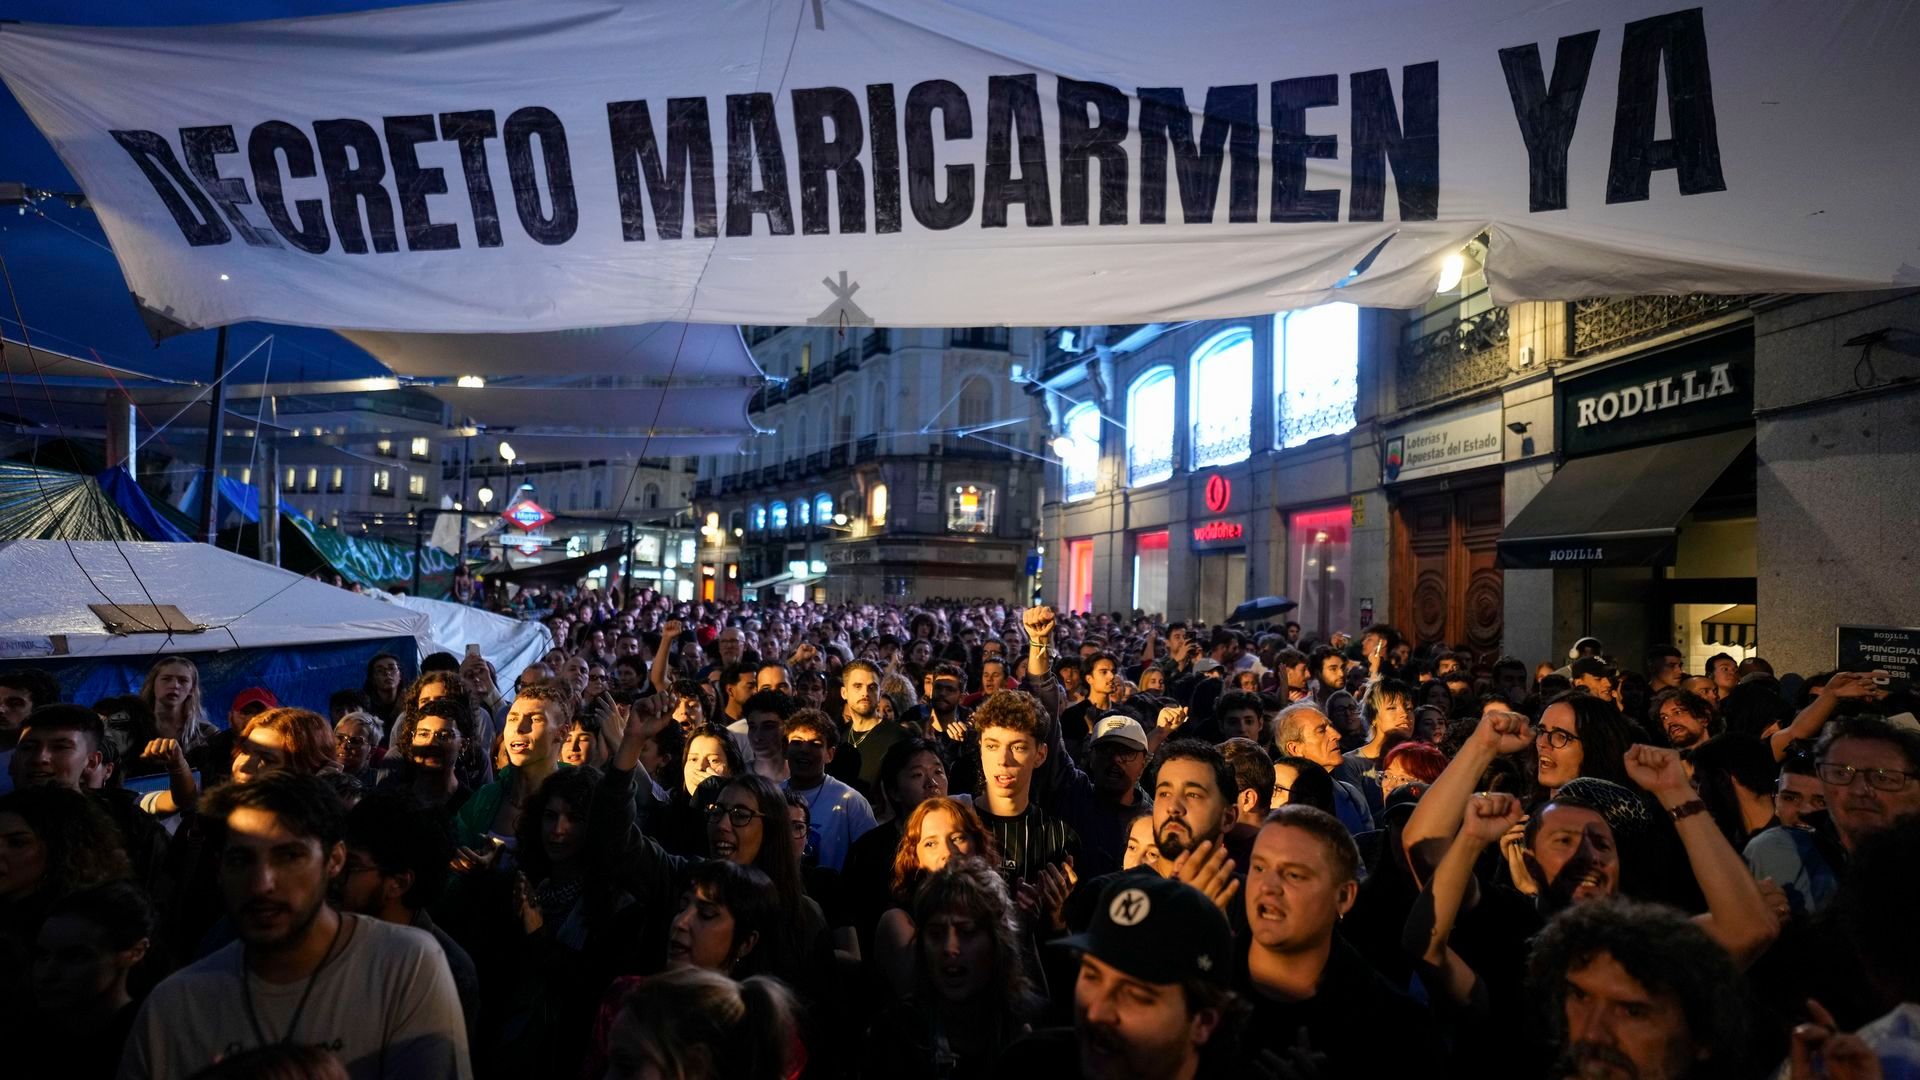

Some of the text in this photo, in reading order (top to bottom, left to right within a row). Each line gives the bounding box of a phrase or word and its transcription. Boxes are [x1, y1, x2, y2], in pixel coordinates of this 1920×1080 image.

[108, 7, 1727, 255] DECRETO MARICARMEN YA
[1577, 363, 1734, 428] RODILLA
[1406, 448, 1445, 466] Apuestas
[1447, 441, 1461, 456] del
[1463, 433, 1497, 453] Estado
[516, 513, 539, 521] Metro
[1549, 548, 1603, 561] RODILLA
[1873, 632, 1909, 640] RODILLA
